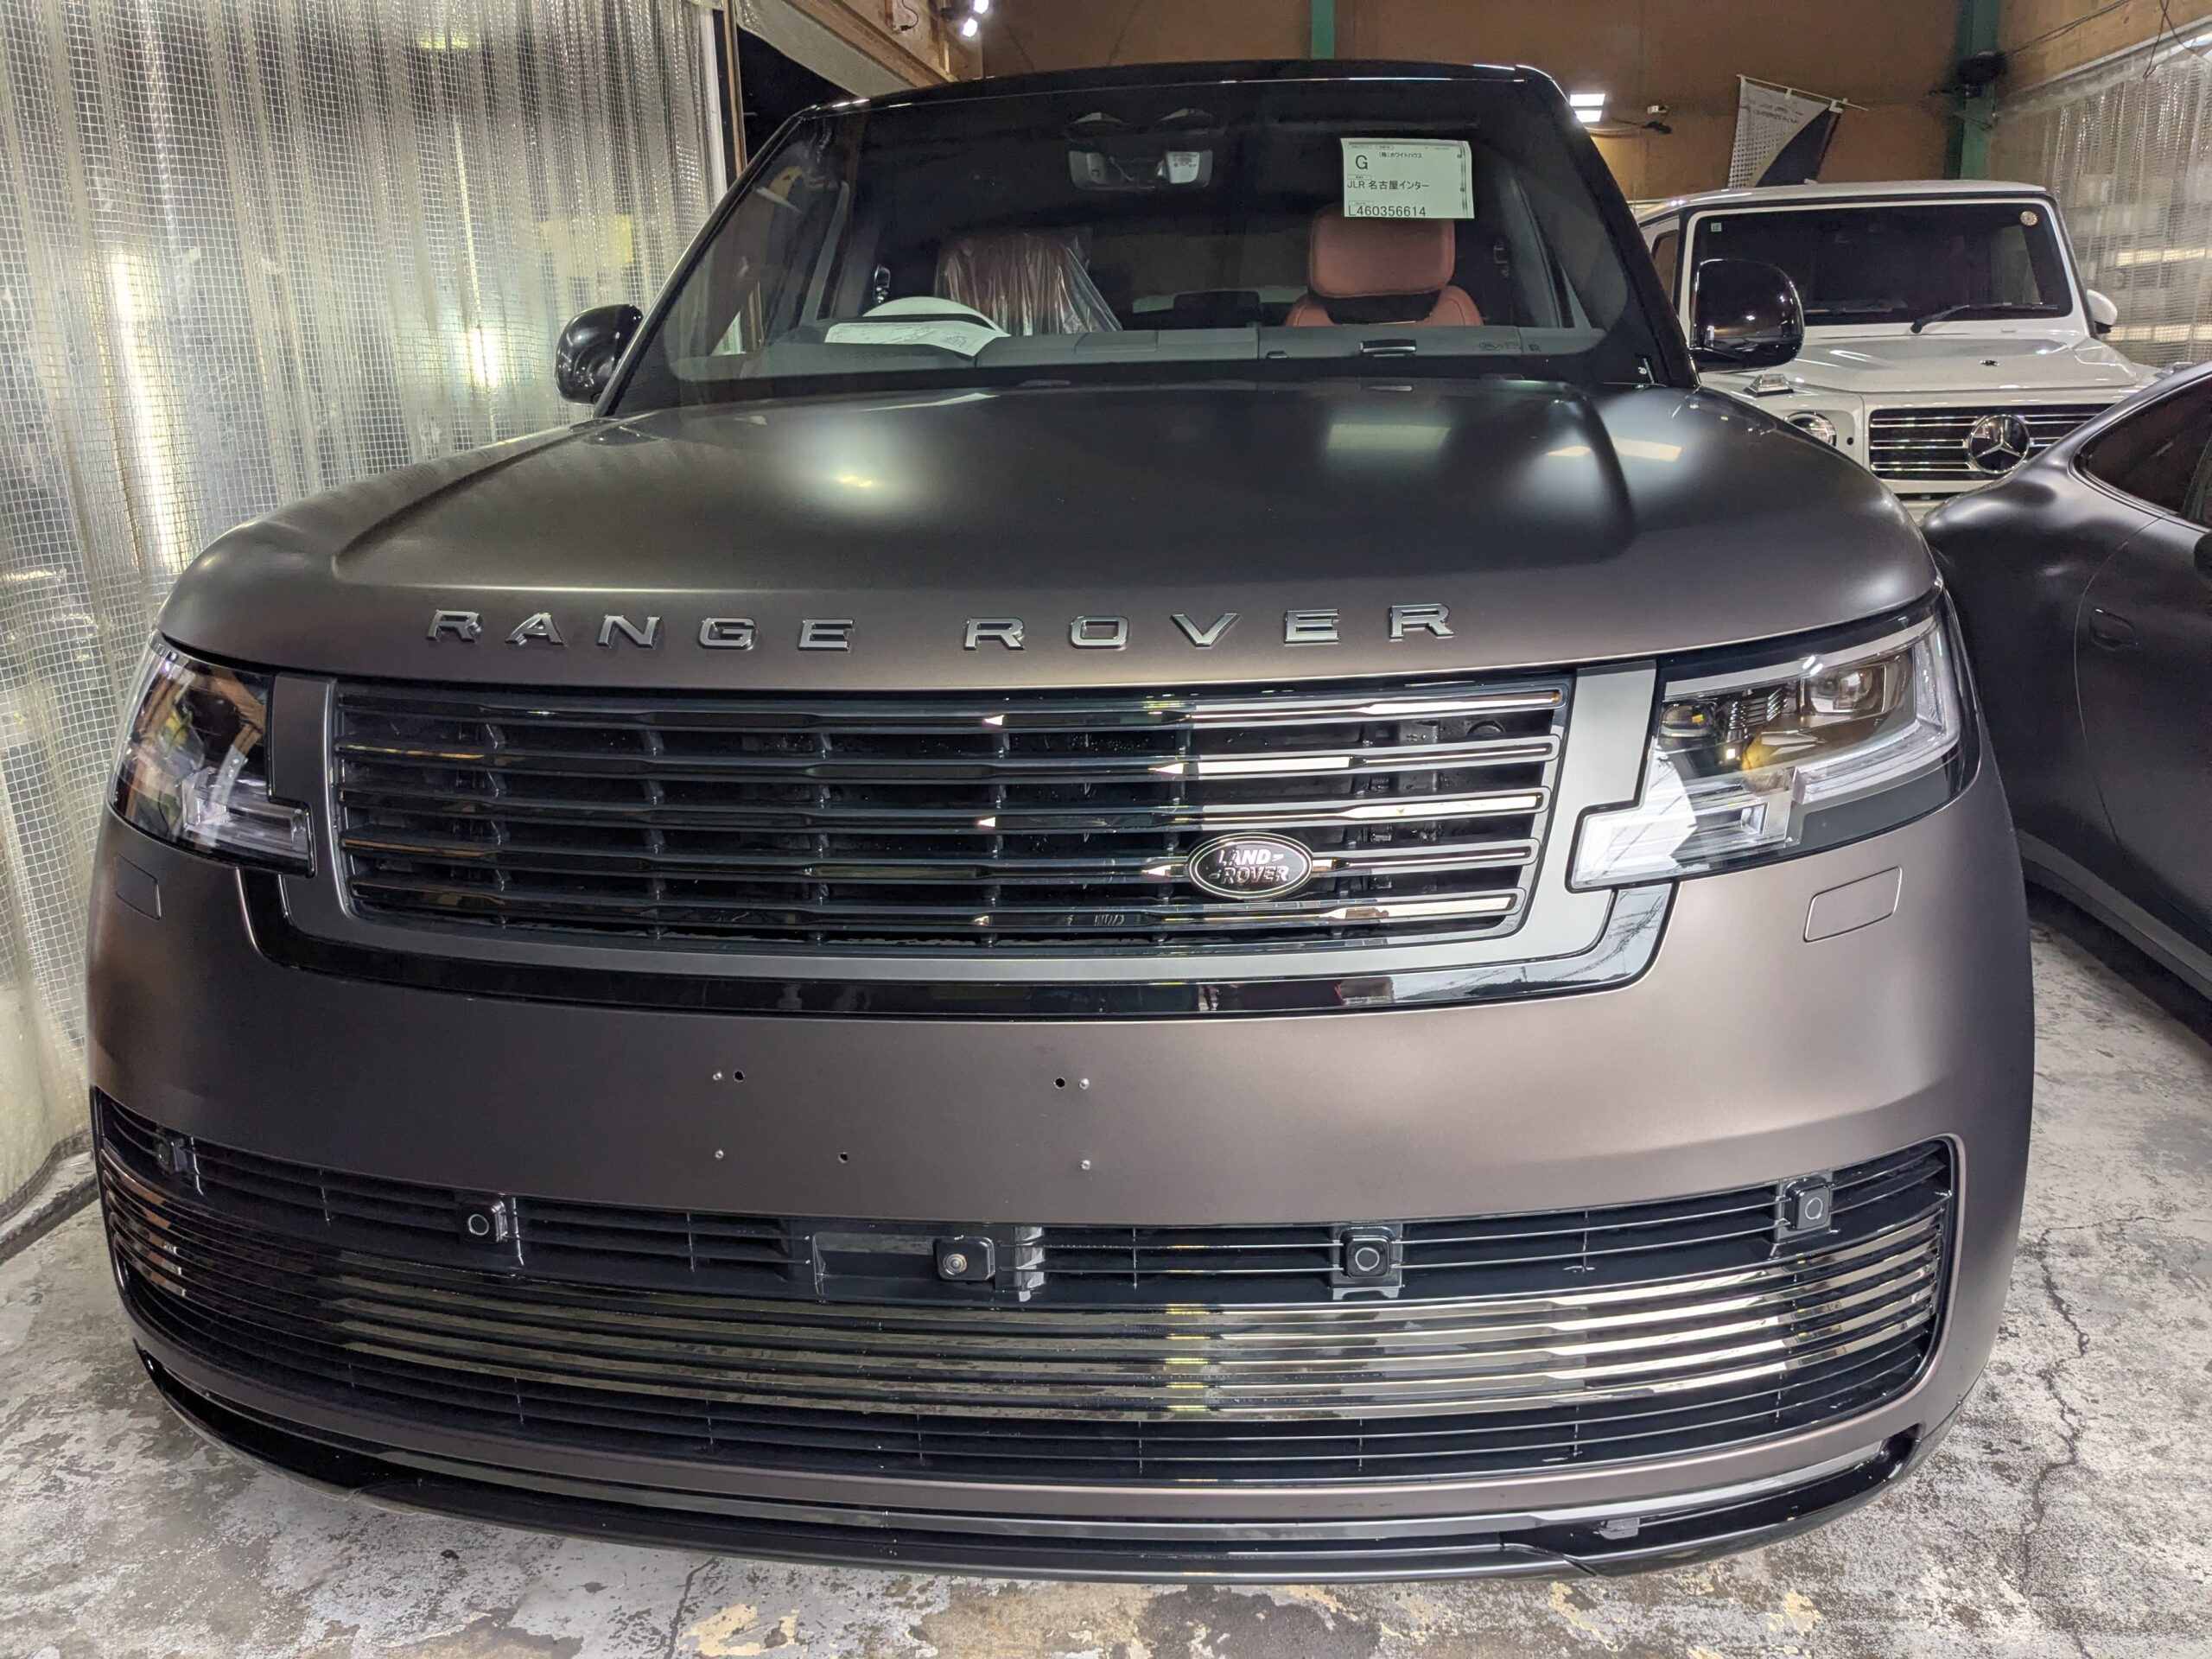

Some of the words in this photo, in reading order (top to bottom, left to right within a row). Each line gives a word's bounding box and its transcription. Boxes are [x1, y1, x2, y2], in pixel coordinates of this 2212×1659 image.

[1355, 155, 1369, 170] G
[1346, 180, 1365, 188] JLR
[1368, 180, 1429, 190] 名古屋インター
[1348, 205, 1427, 217] L460356614
[426, 610, 856, 652] RANGE
[963, 602, 1457, 652] ROVER
